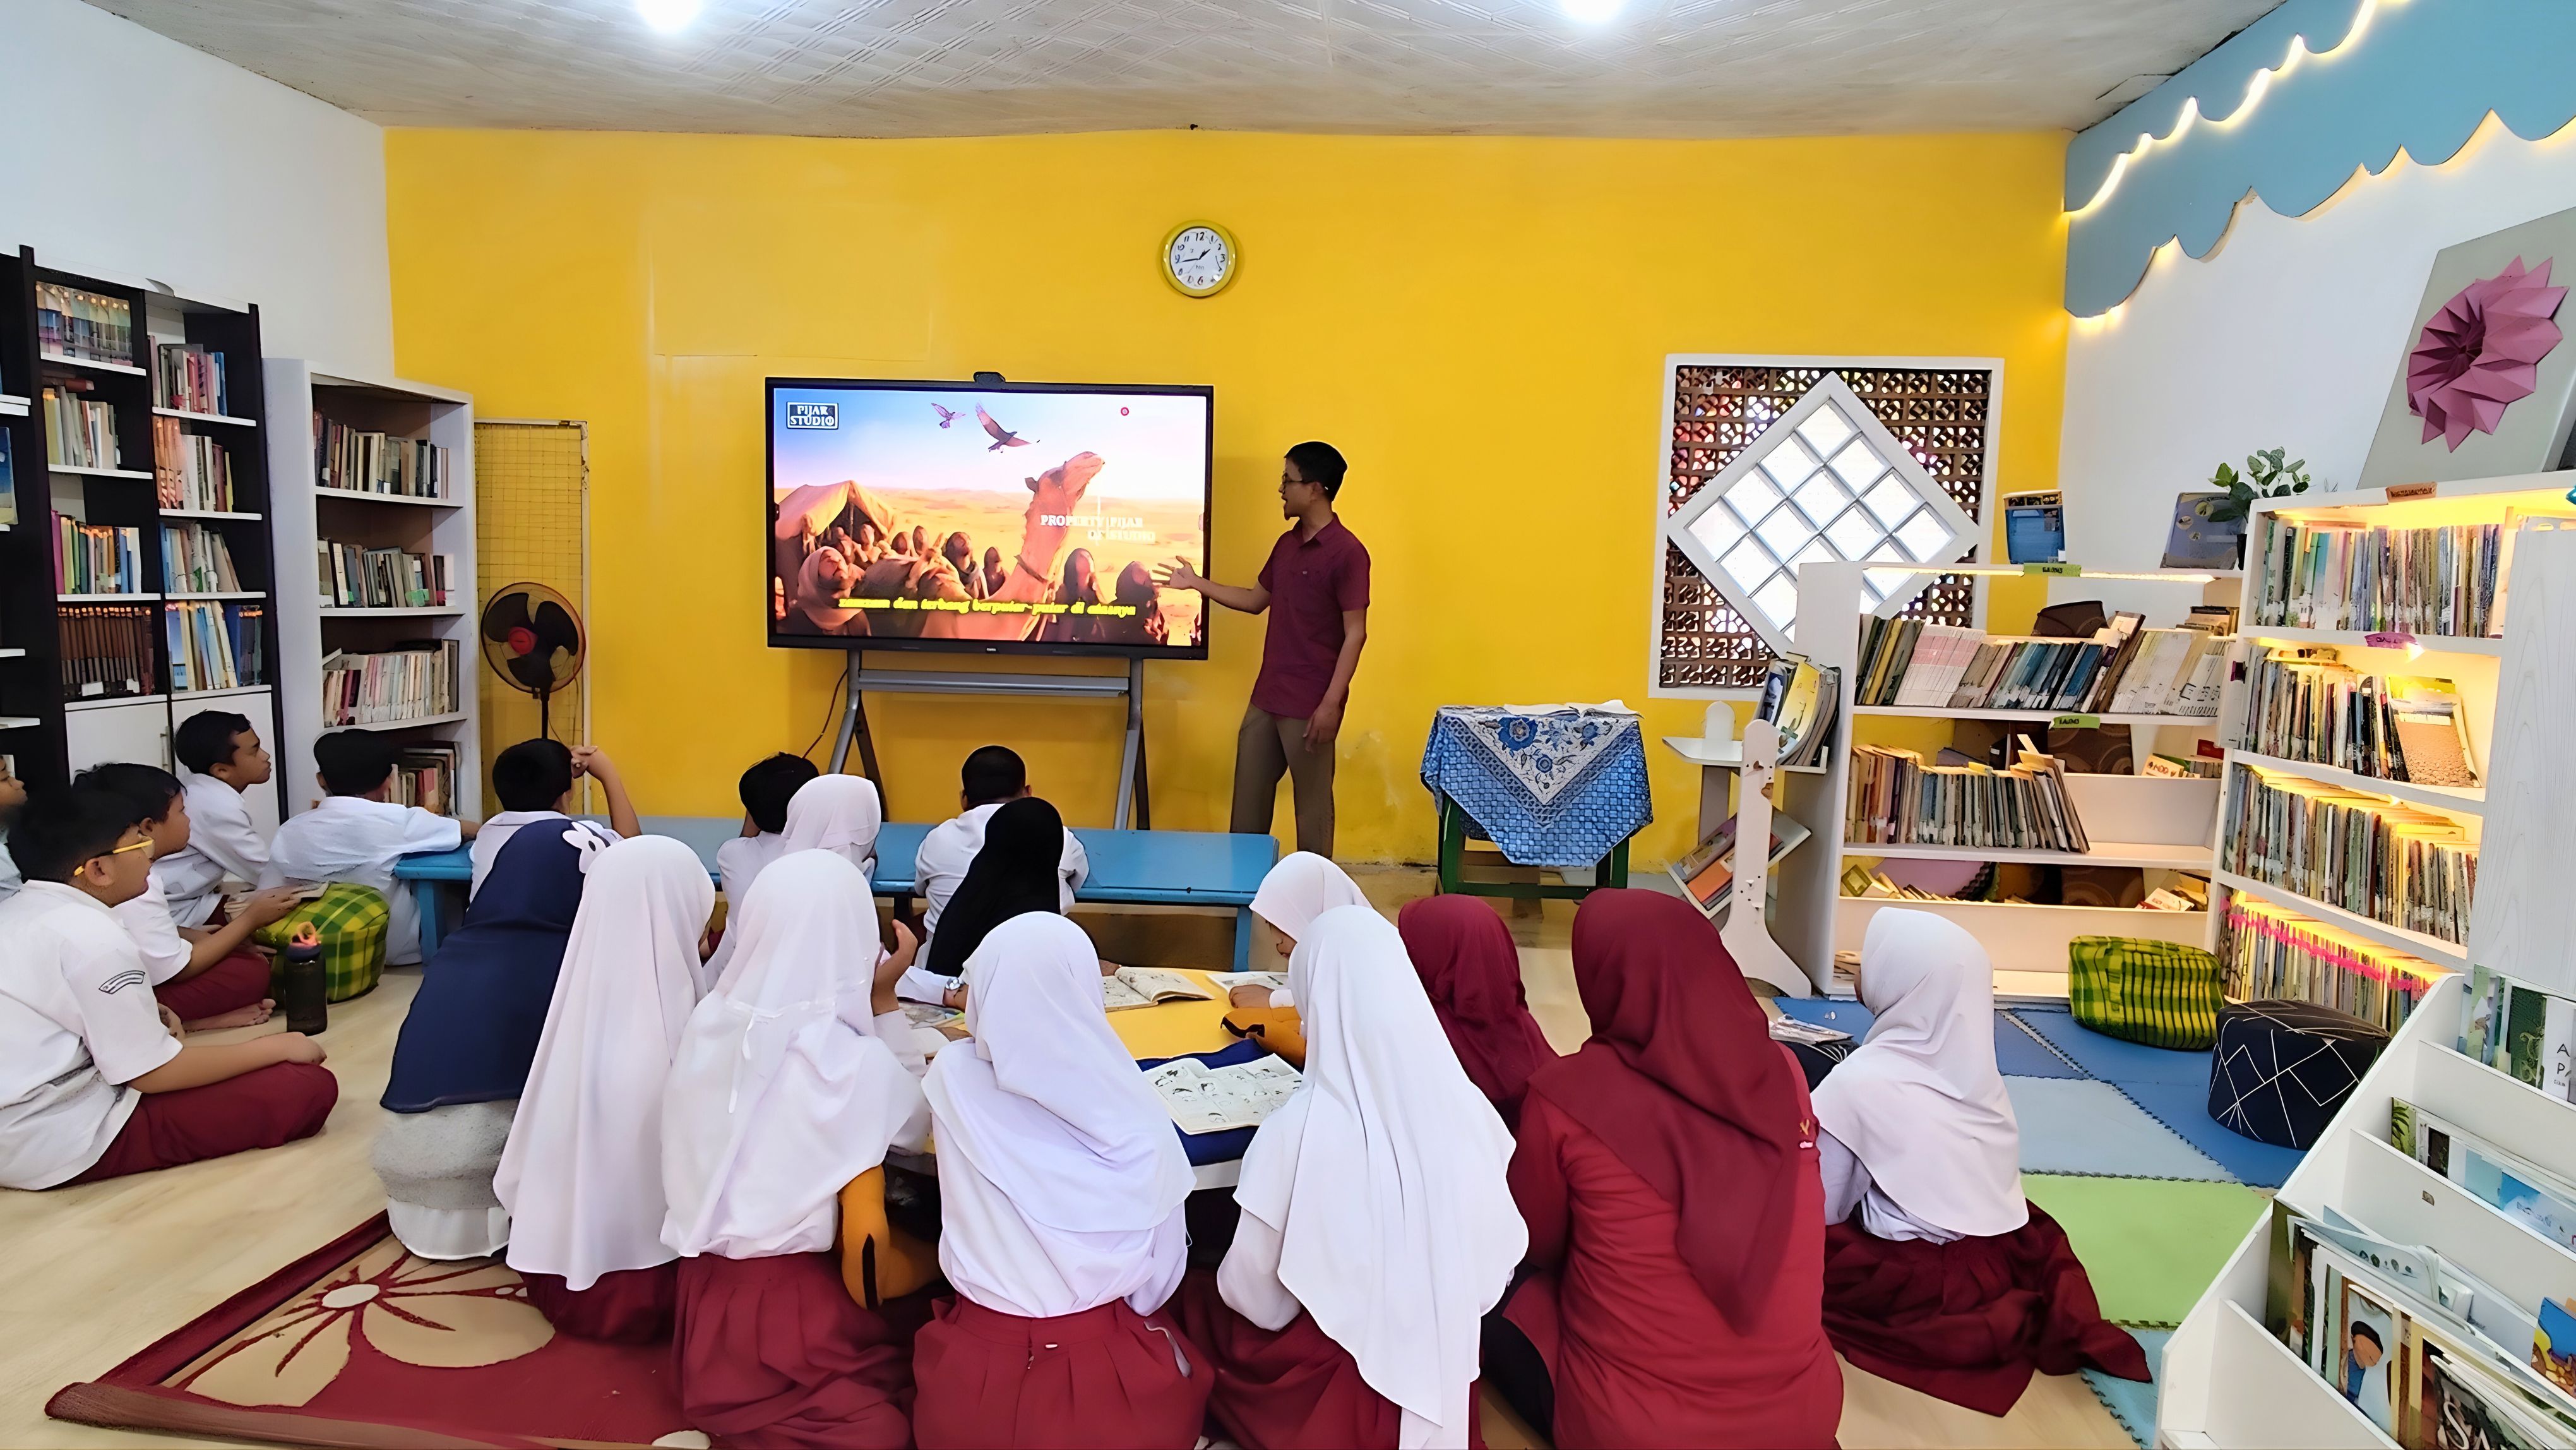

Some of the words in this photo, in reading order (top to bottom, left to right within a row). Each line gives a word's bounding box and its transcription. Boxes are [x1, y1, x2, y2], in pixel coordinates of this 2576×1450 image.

[1195, 232, 1205, 241] 12
[797, 405, 828, 417] PIJAR
[790, 416, 835, 426] STUDIO
[1041, 515, 1105, 527] PROPERTY
[1070, 601, 1085, 614] di
